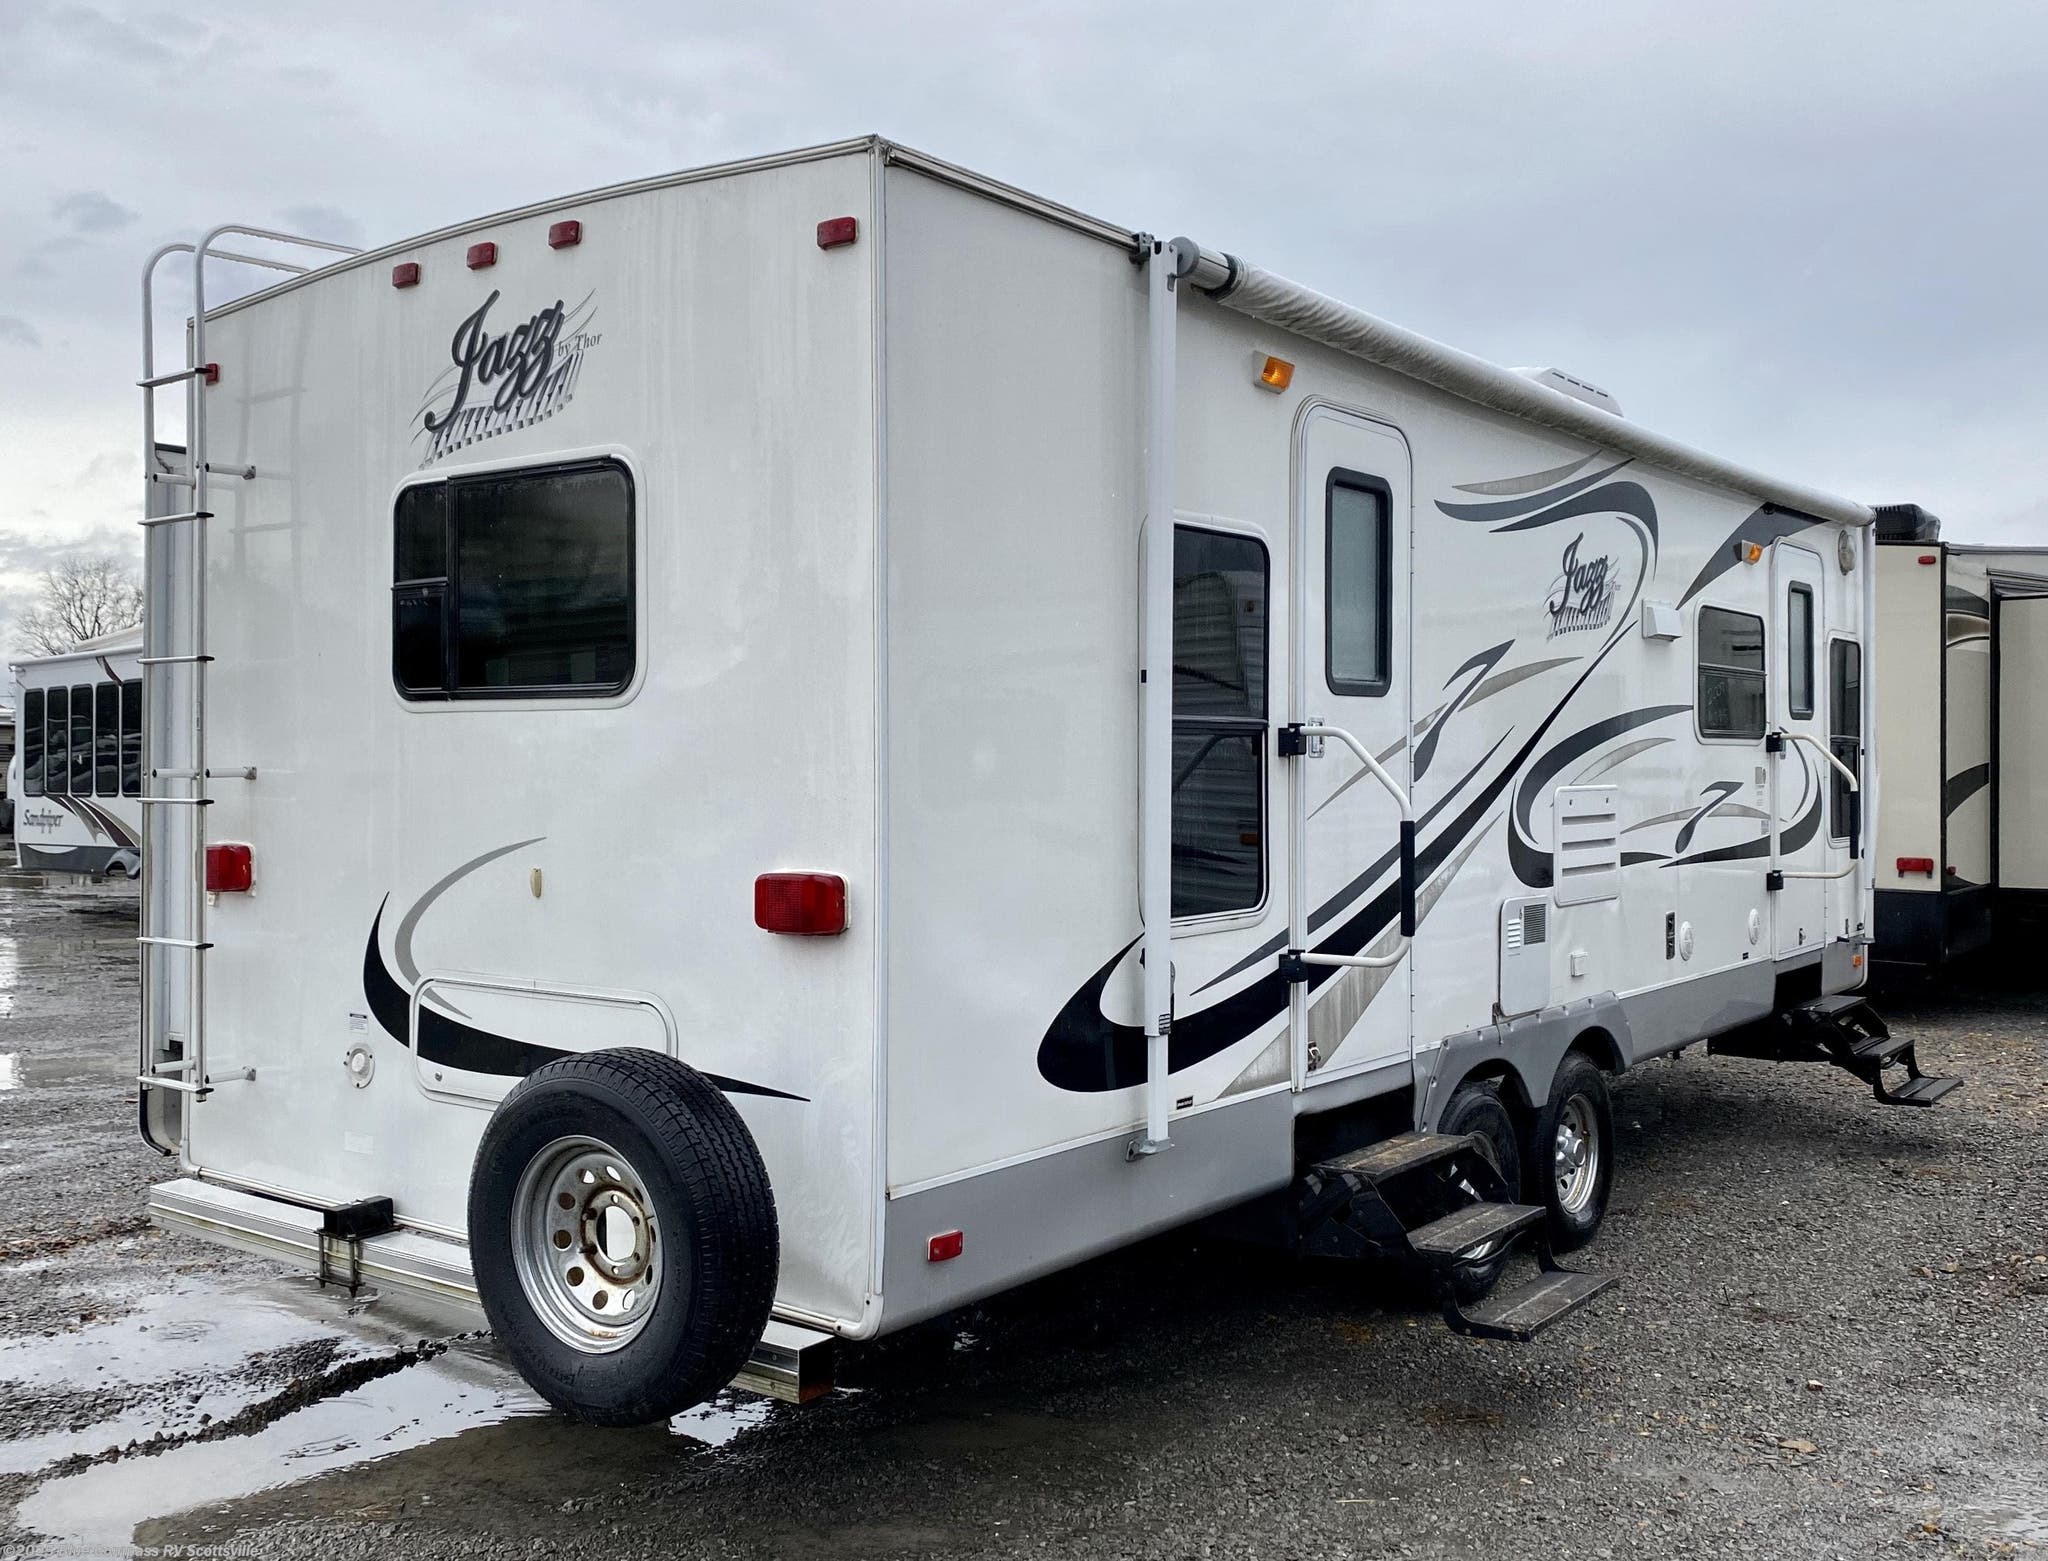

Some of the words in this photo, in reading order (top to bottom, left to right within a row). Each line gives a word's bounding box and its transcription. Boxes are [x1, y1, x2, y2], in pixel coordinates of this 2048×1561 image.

[424, 289, 565, 433] Jazz
[575, 333, 602, 350] Thor
[1549, 532, 1608, 616] Jazz
